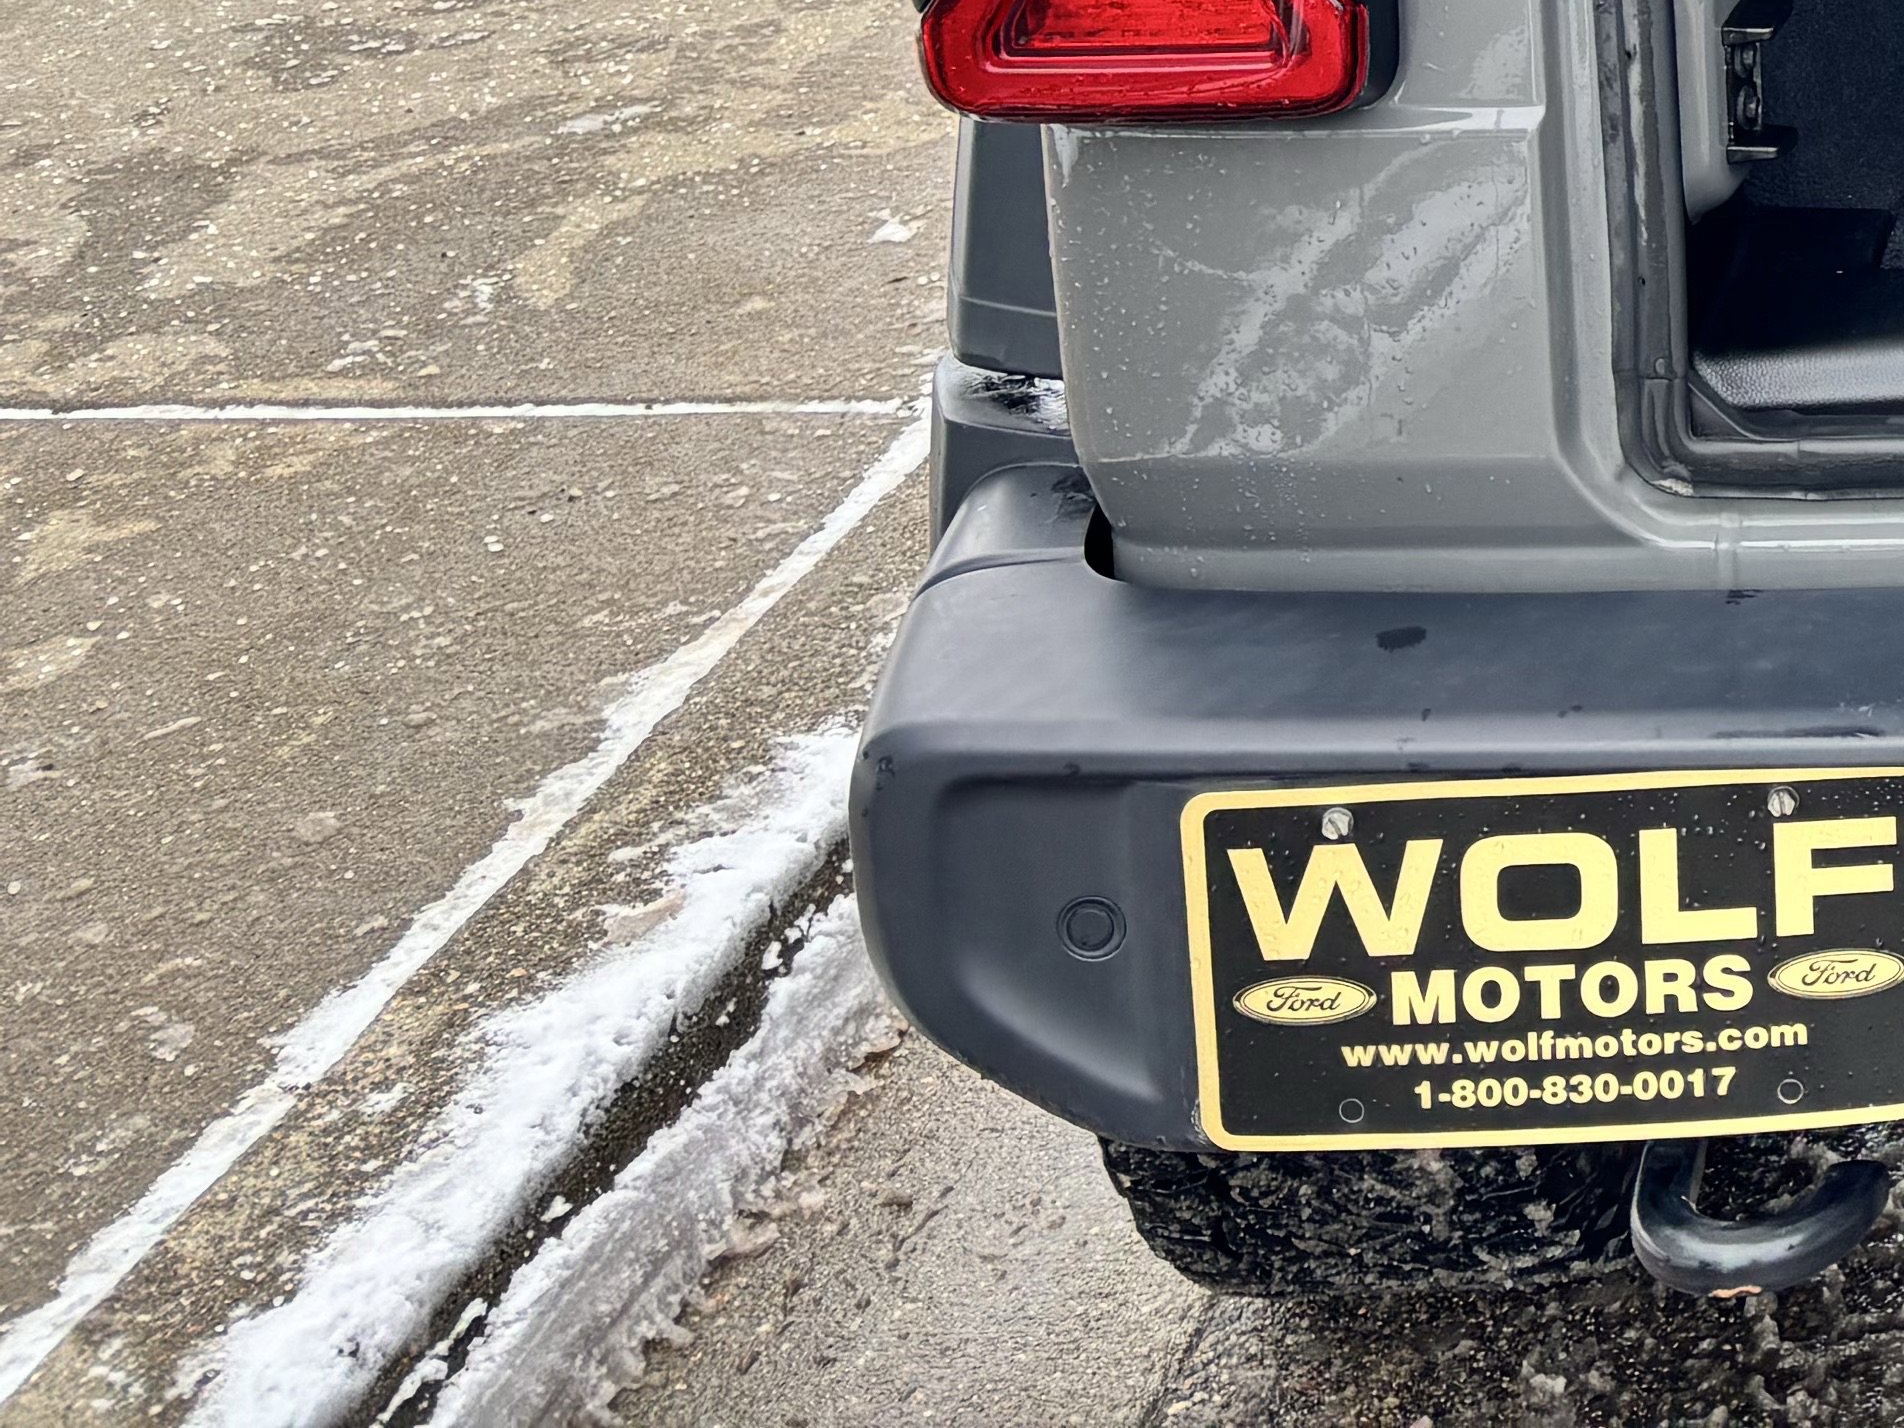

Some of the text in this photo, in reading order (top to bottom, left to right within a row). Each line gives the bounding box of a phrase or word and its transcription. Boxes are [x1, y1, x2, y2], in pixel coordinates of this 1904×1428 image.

[1227, 815, 1898, 962] WOLF
[1389, 952, 1755, 1027] MOTORS
[1798, 956, 1877, 990] Ford
[1263, 984, 1343, 1015] Ford
[1340, 1020, 1808, 1068] www.wolfmotors.com
[1413, 1066, 1737, 1111] 1-800-830-0017
